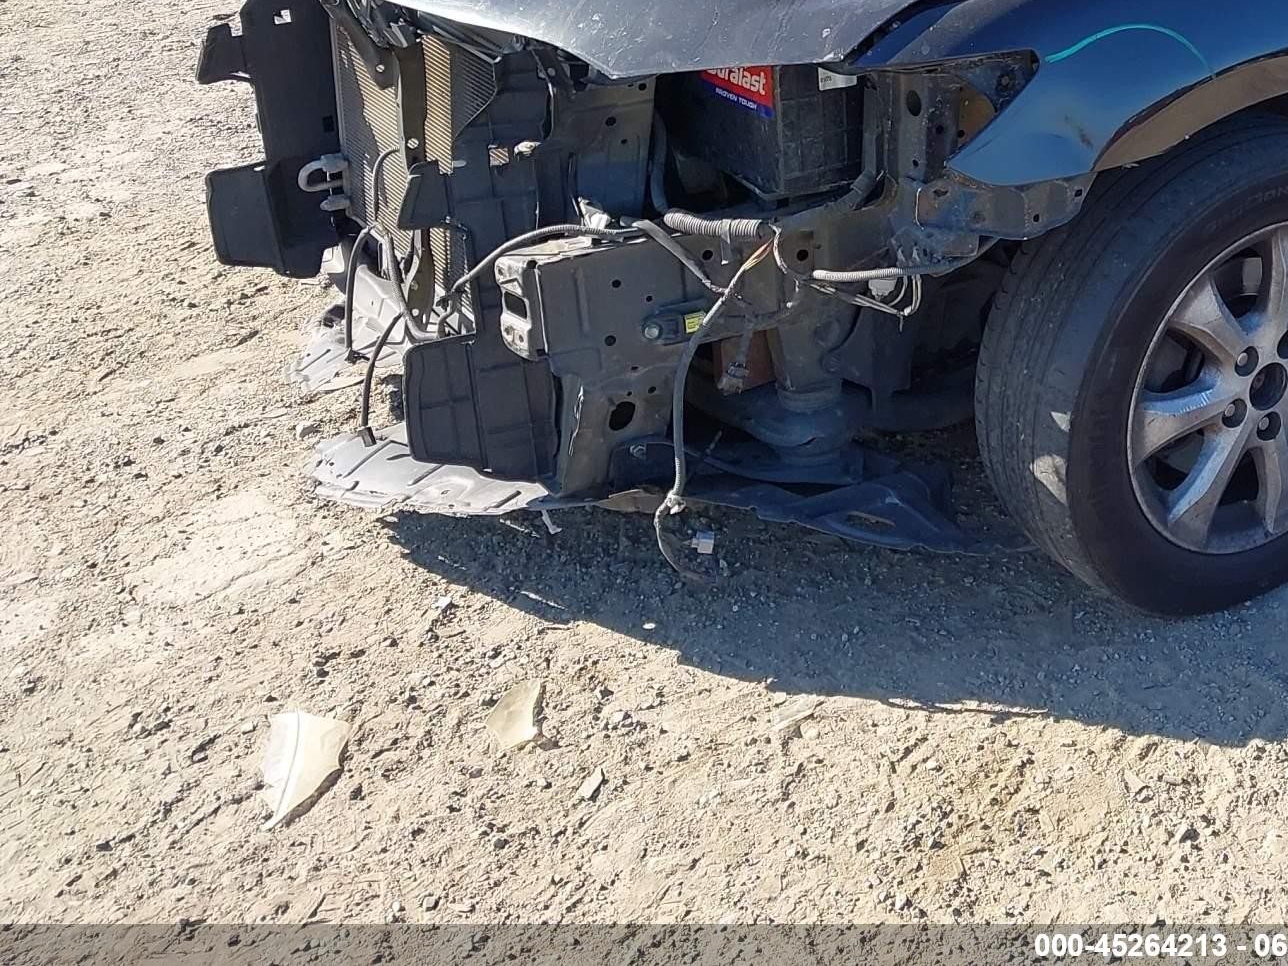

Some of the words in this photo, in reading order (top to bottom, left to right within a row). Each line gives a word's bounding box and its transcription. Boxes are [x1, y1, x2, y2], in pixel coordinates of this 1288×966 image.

[706, 68, 766, 95] uralast
[715, 87, 738, 102] PROVEN
[738, 97, 758, 111] TOUGH
